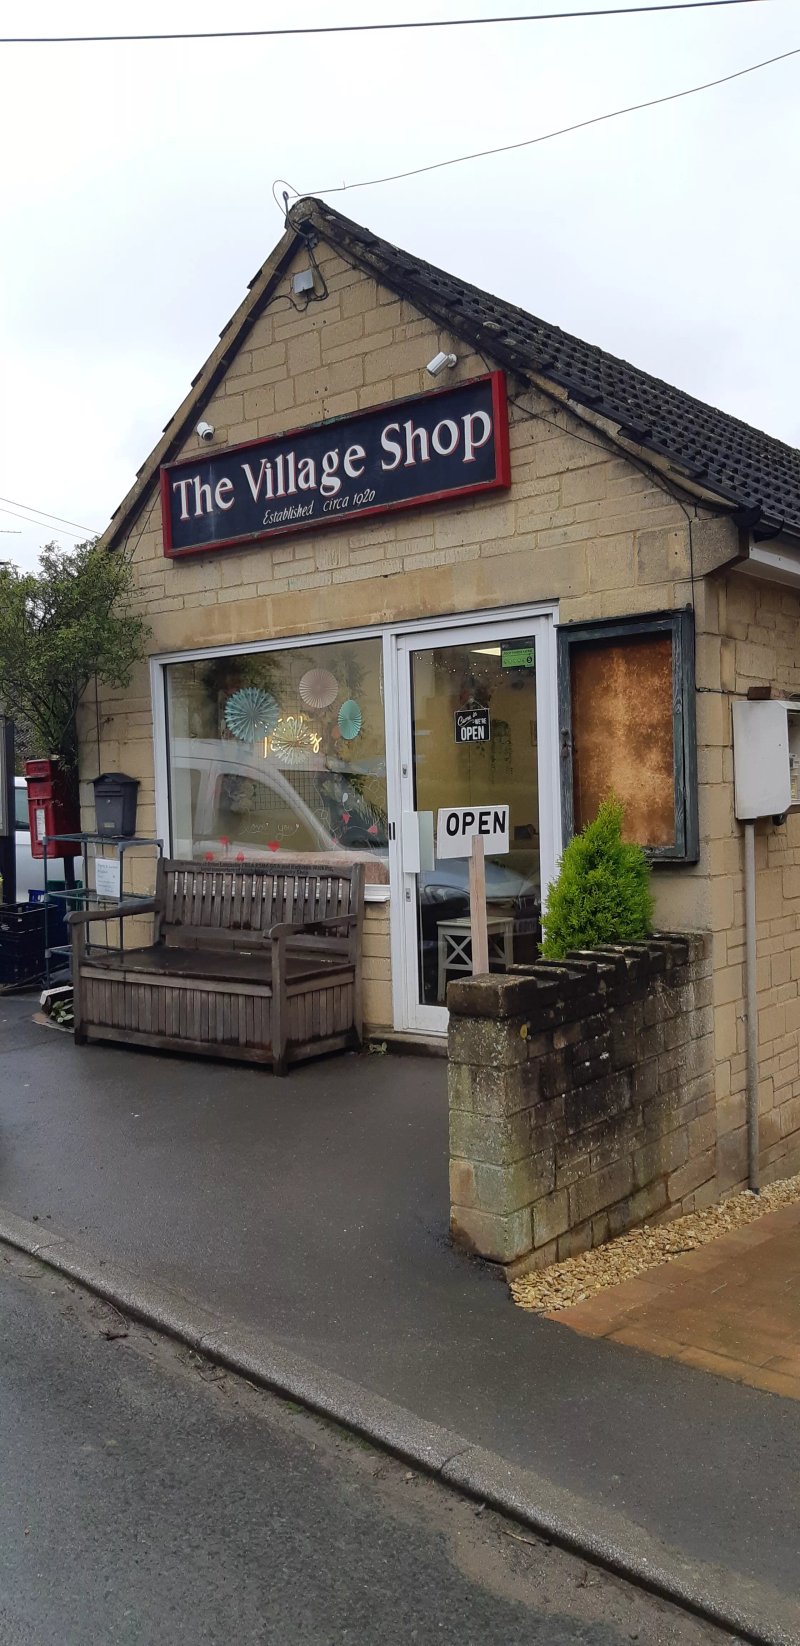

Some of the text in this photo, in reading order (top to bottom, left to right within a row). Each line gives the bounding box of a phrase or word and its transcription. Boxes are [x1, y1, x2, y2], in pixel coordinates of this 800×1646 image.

[172, 410, 493, 521] The Village Shop
[262, 488, 376, 525] Established circa 1920
[460, 725, 485, 741] OPEN
[446, 810, 506, 837] OPEN
